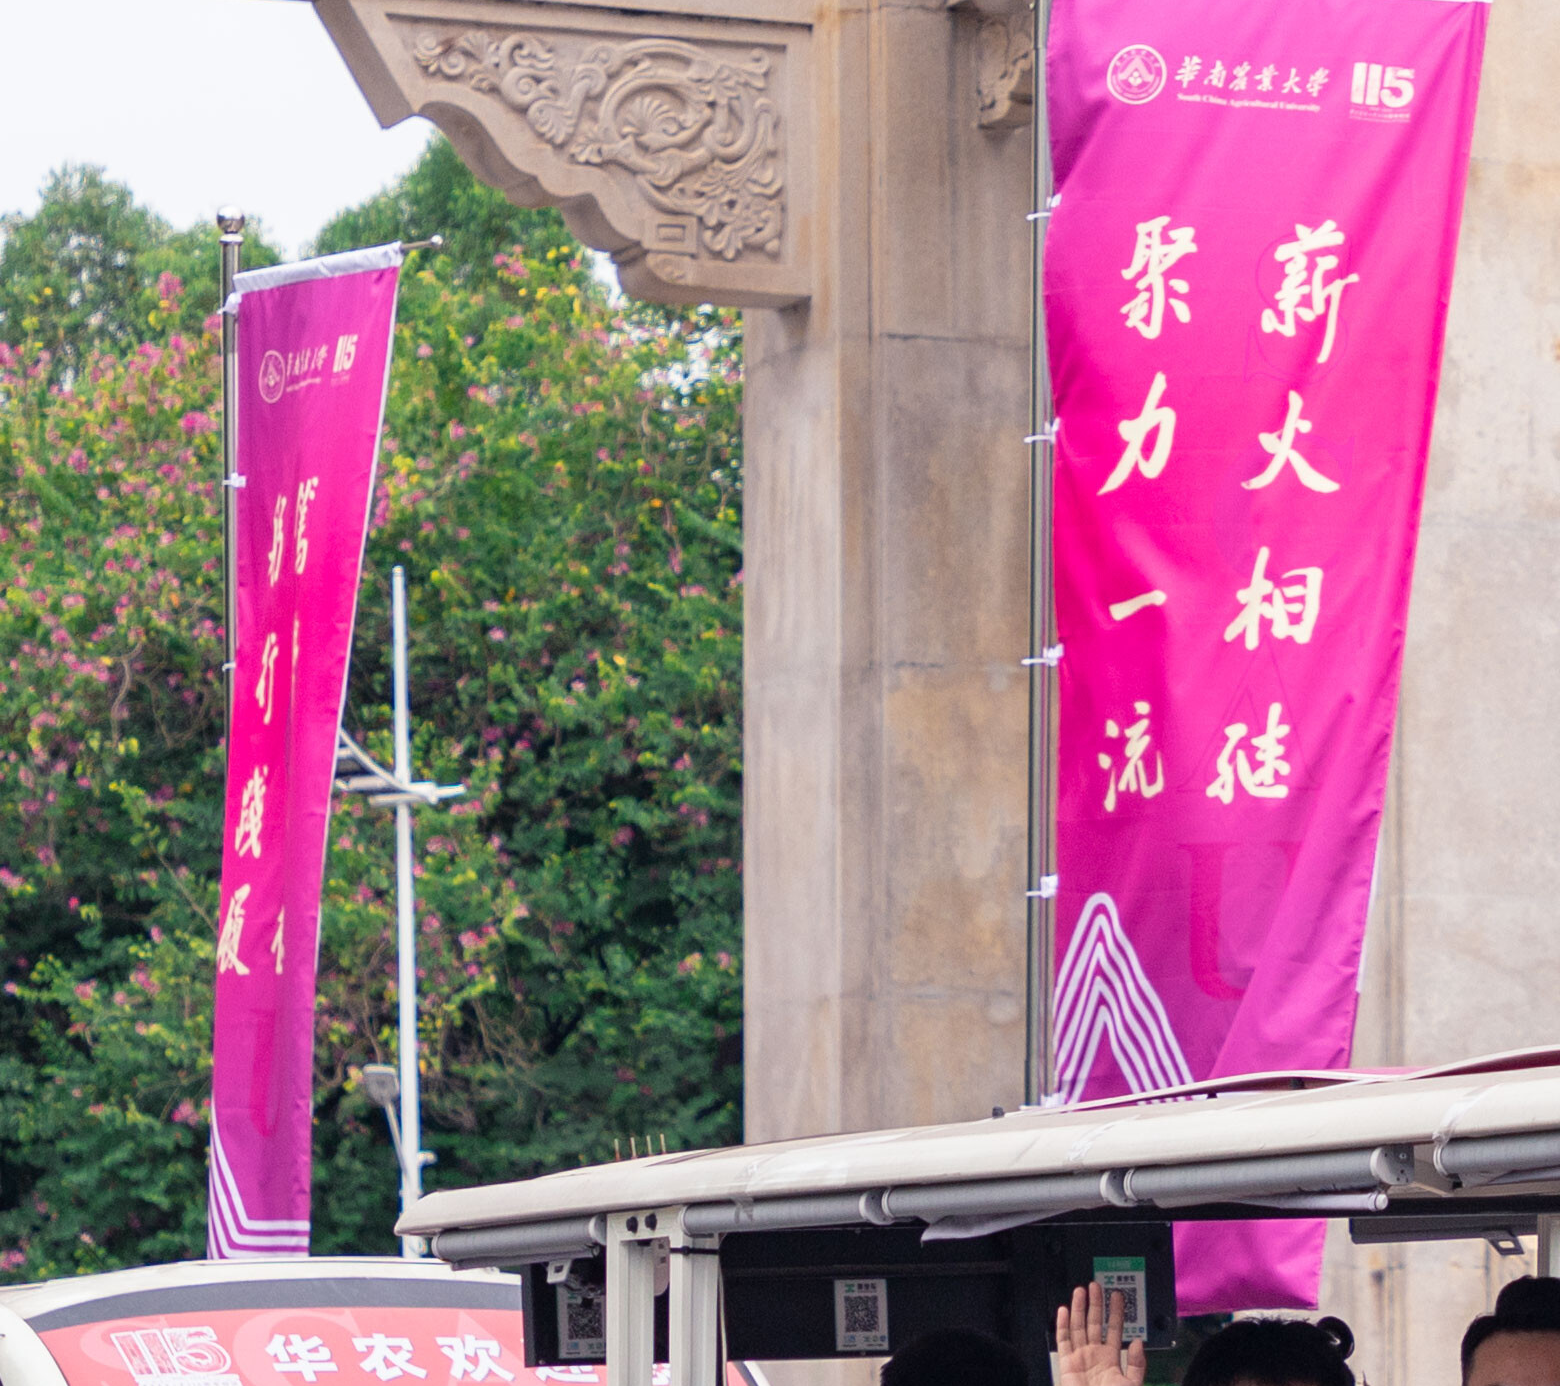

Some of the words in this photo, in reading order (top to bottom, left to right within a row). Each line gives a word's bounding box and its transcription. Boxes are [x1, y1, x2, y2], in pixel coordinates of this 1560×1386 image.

[1350, 62, 1415, 109] 115
[1096, 215, 1198, 812] 聚力一流
